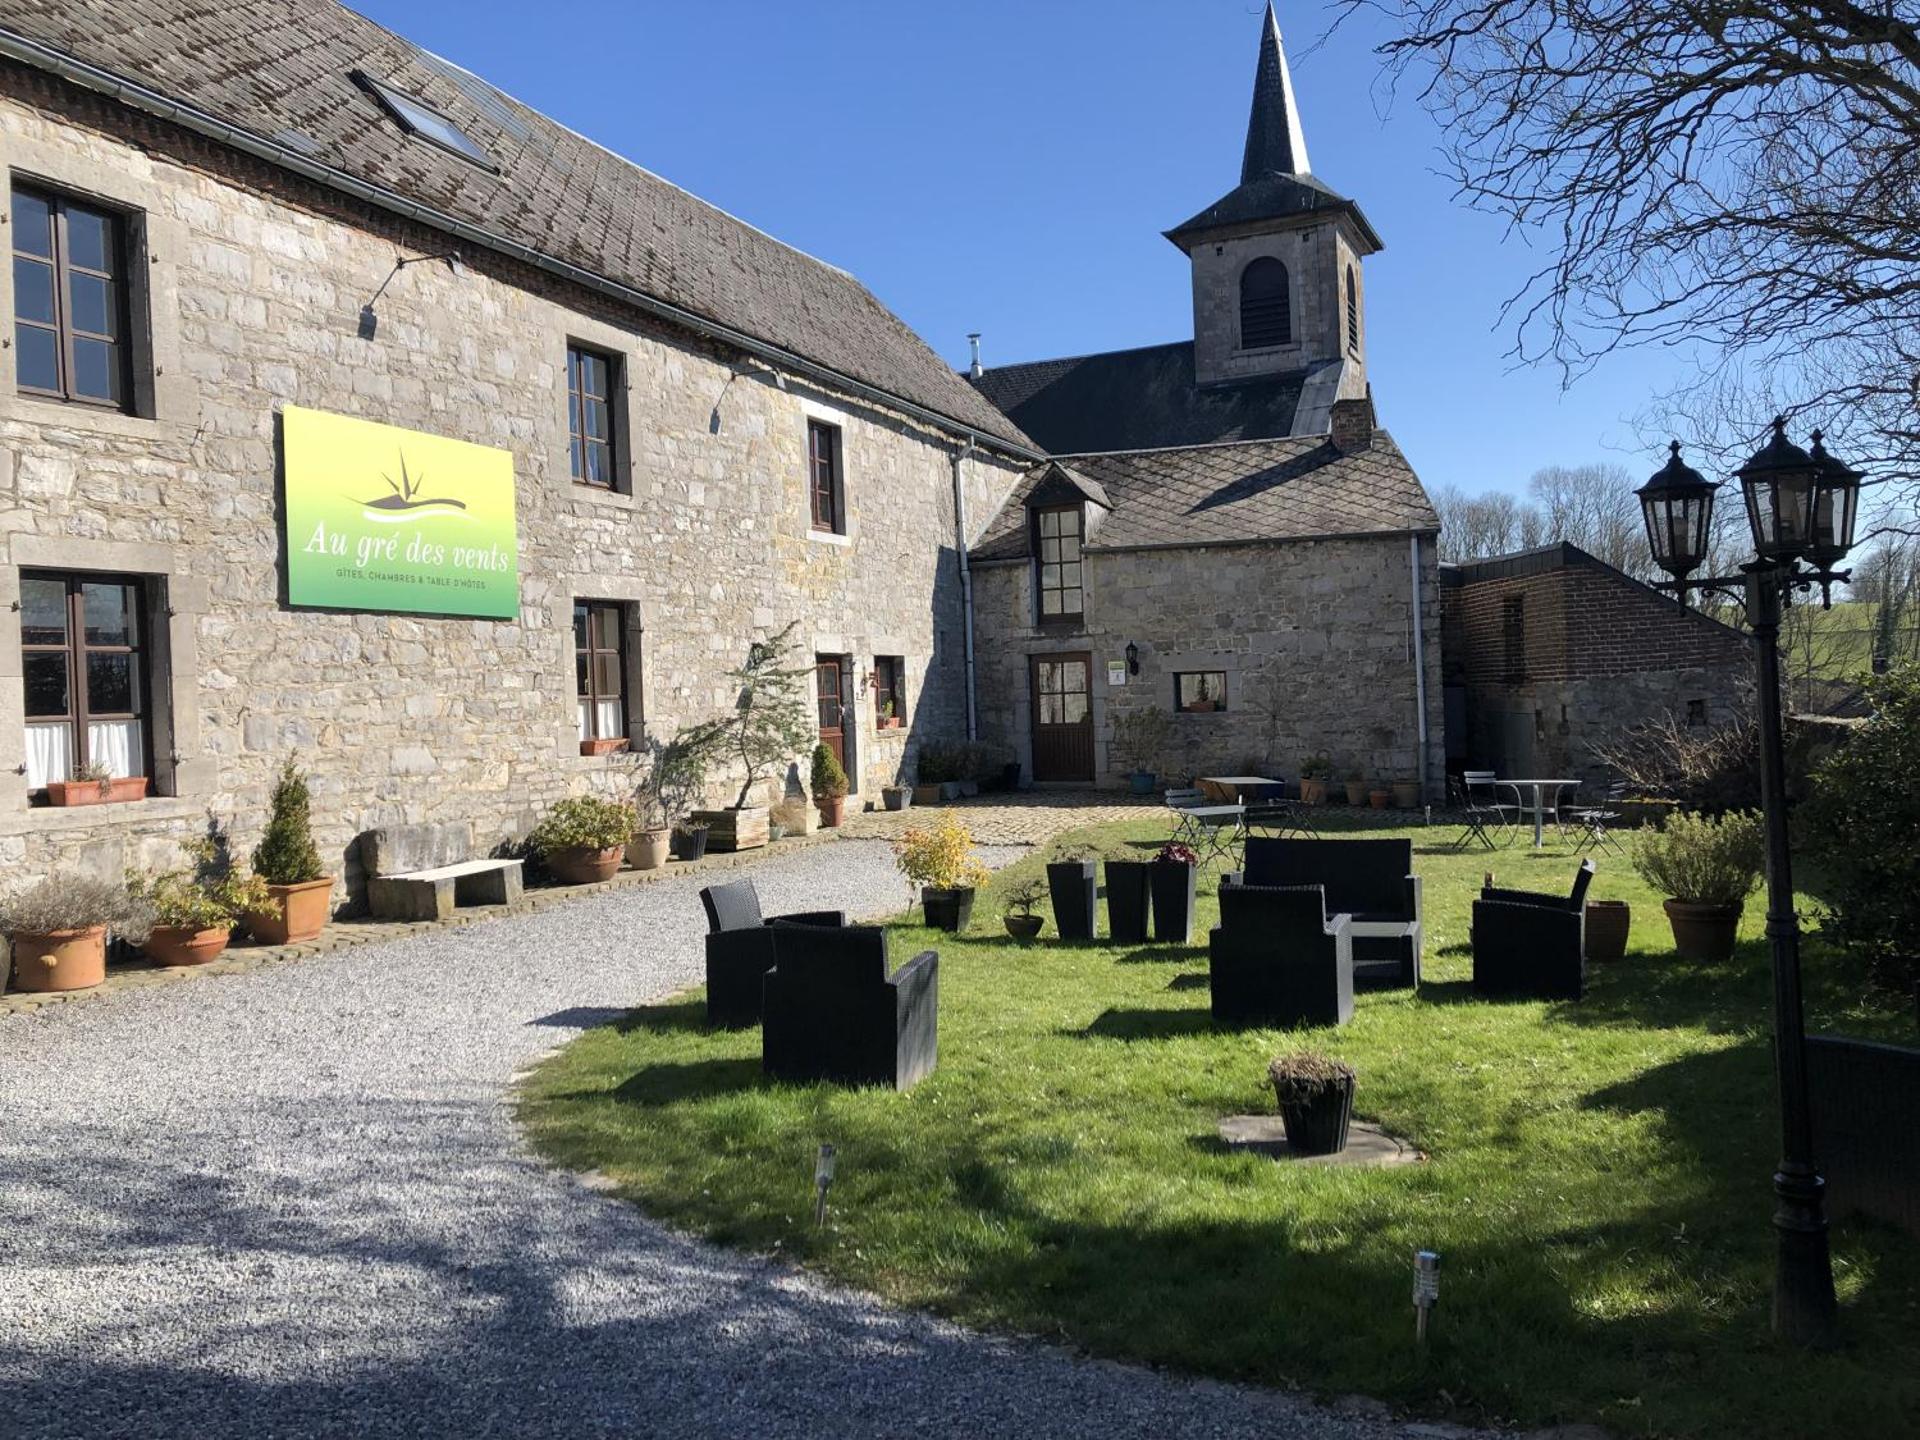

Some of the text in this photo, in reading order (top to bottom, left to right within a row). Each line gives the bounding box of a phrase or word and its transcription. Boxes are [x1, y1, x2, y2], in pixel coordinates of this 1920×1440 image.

[304, 520, 509, 572] Au gré des vents
[368, 571, 416, 584] CHAMBRES
[427, 576, 450, 587] TABLE
